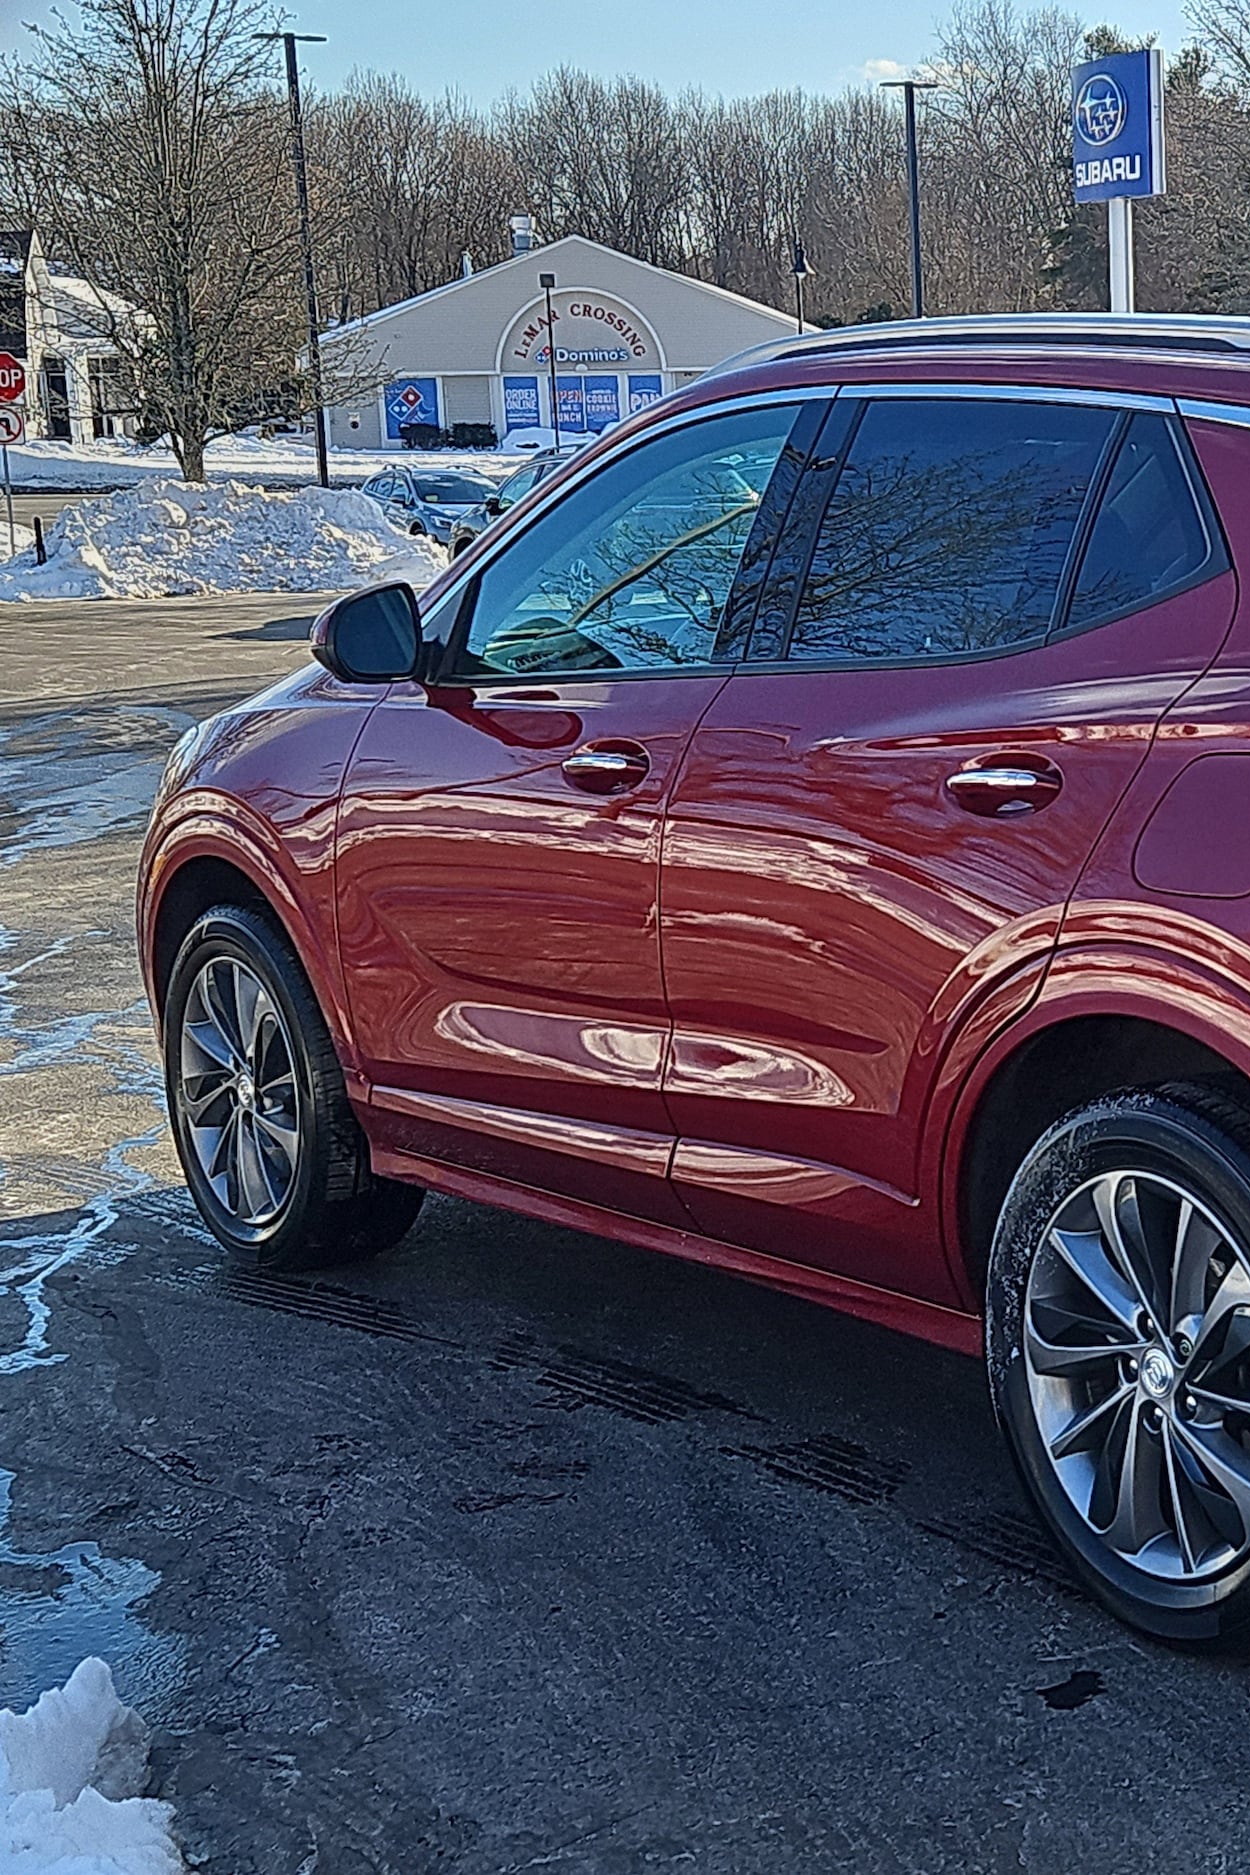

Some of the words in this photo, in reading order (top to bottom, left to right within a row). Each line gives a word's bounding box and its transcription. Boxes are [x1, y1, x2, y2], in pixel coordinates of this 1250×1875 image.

[1075, 154, 1141, 187] SUBARU
[569, 303, 646, 358] CROSSING
[555, 347, 628, 362] Domino's
[0, 369, 23, 388] OP
[506, 388, 537, 400] ORDER
[506, 400, 538, 410] ONLINE
